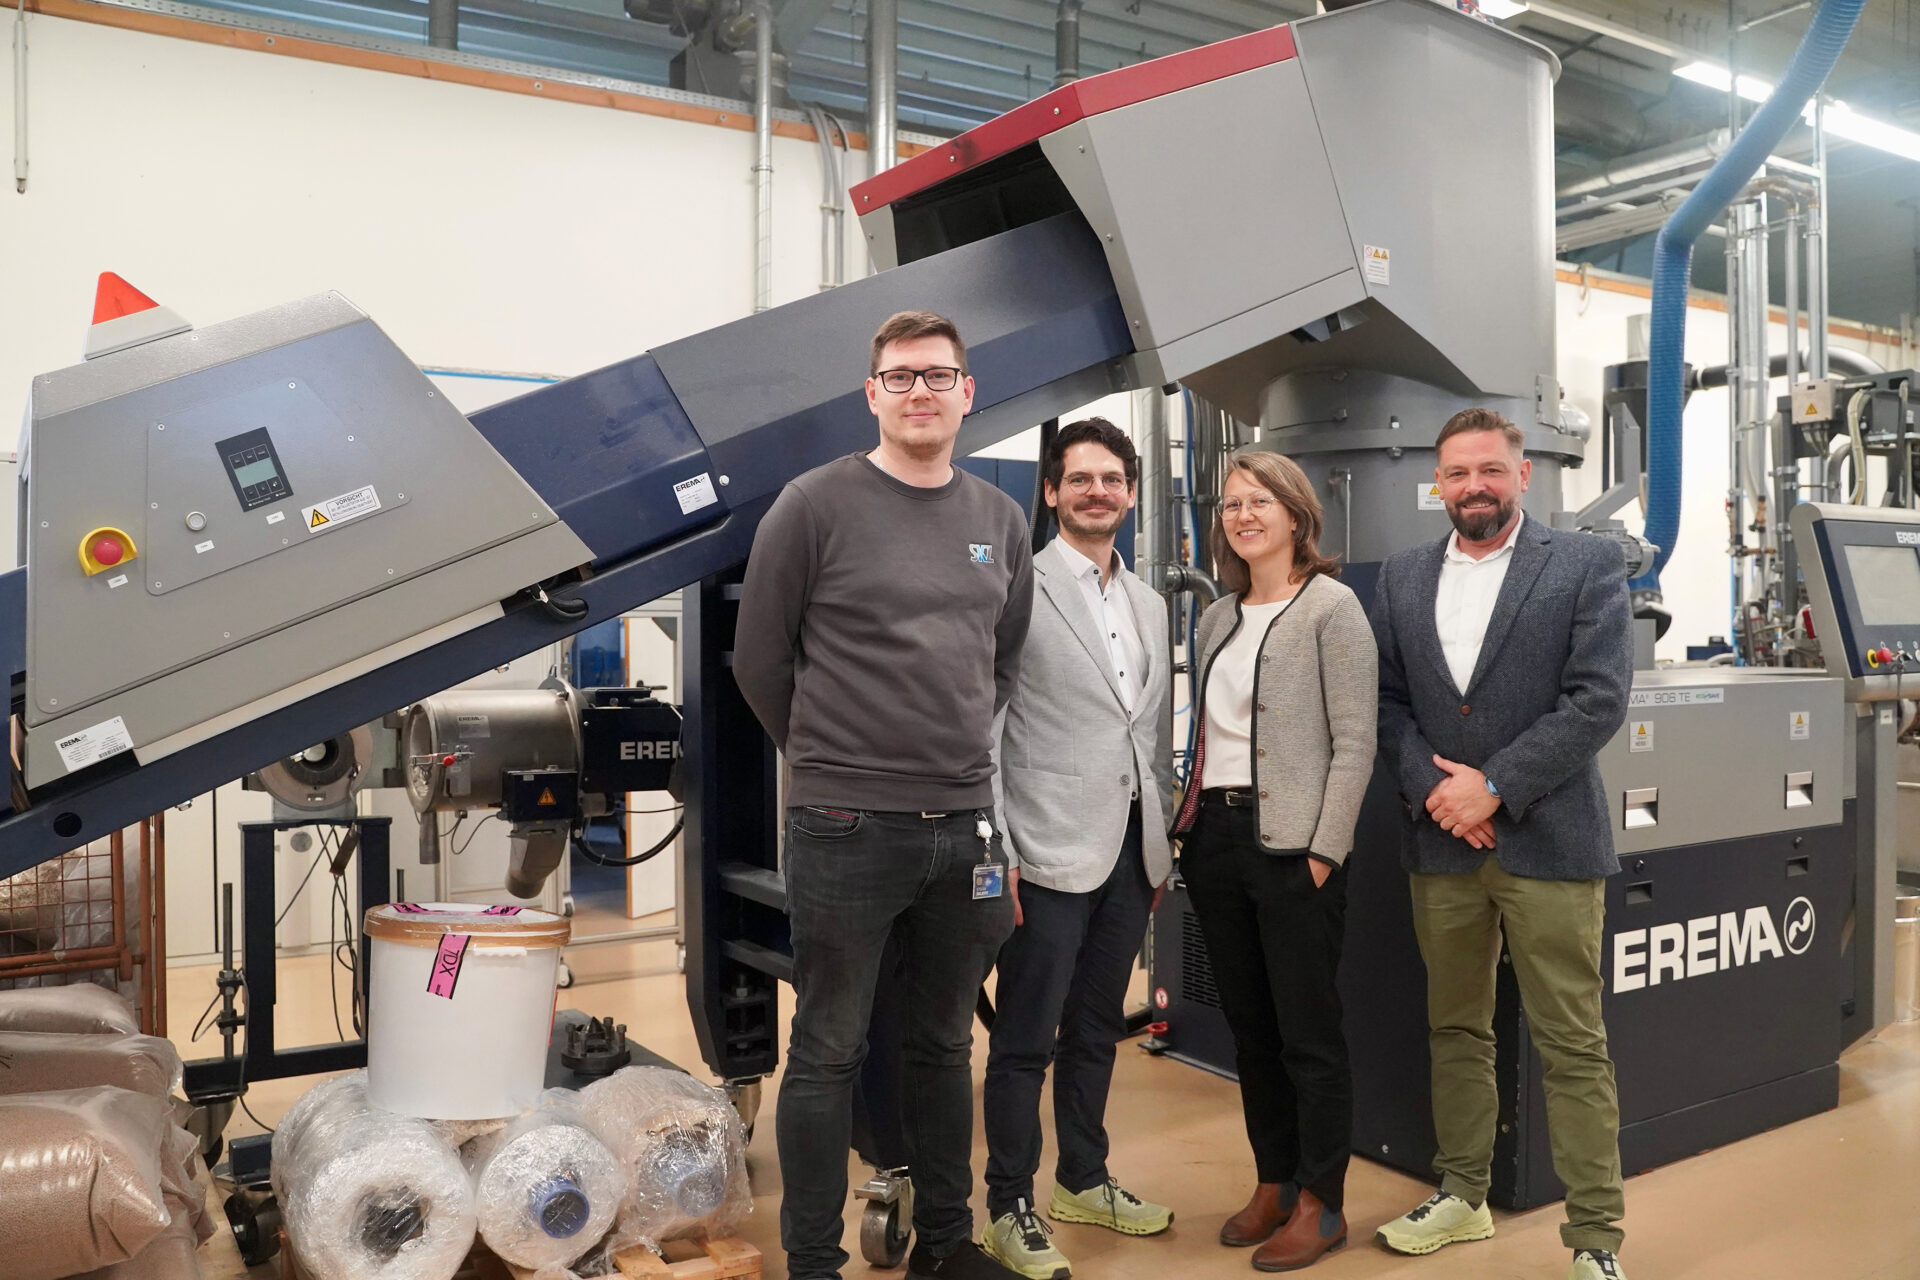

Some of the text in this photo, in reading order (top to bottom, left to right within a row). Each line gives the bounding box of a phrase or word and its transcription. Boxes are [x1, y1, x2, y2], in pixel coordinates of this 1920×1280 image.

[675, 478, 702, 492] EREMA
[60, 737, 82, 749] EREMA
[1613, 905, 1785, 994] EREMA
